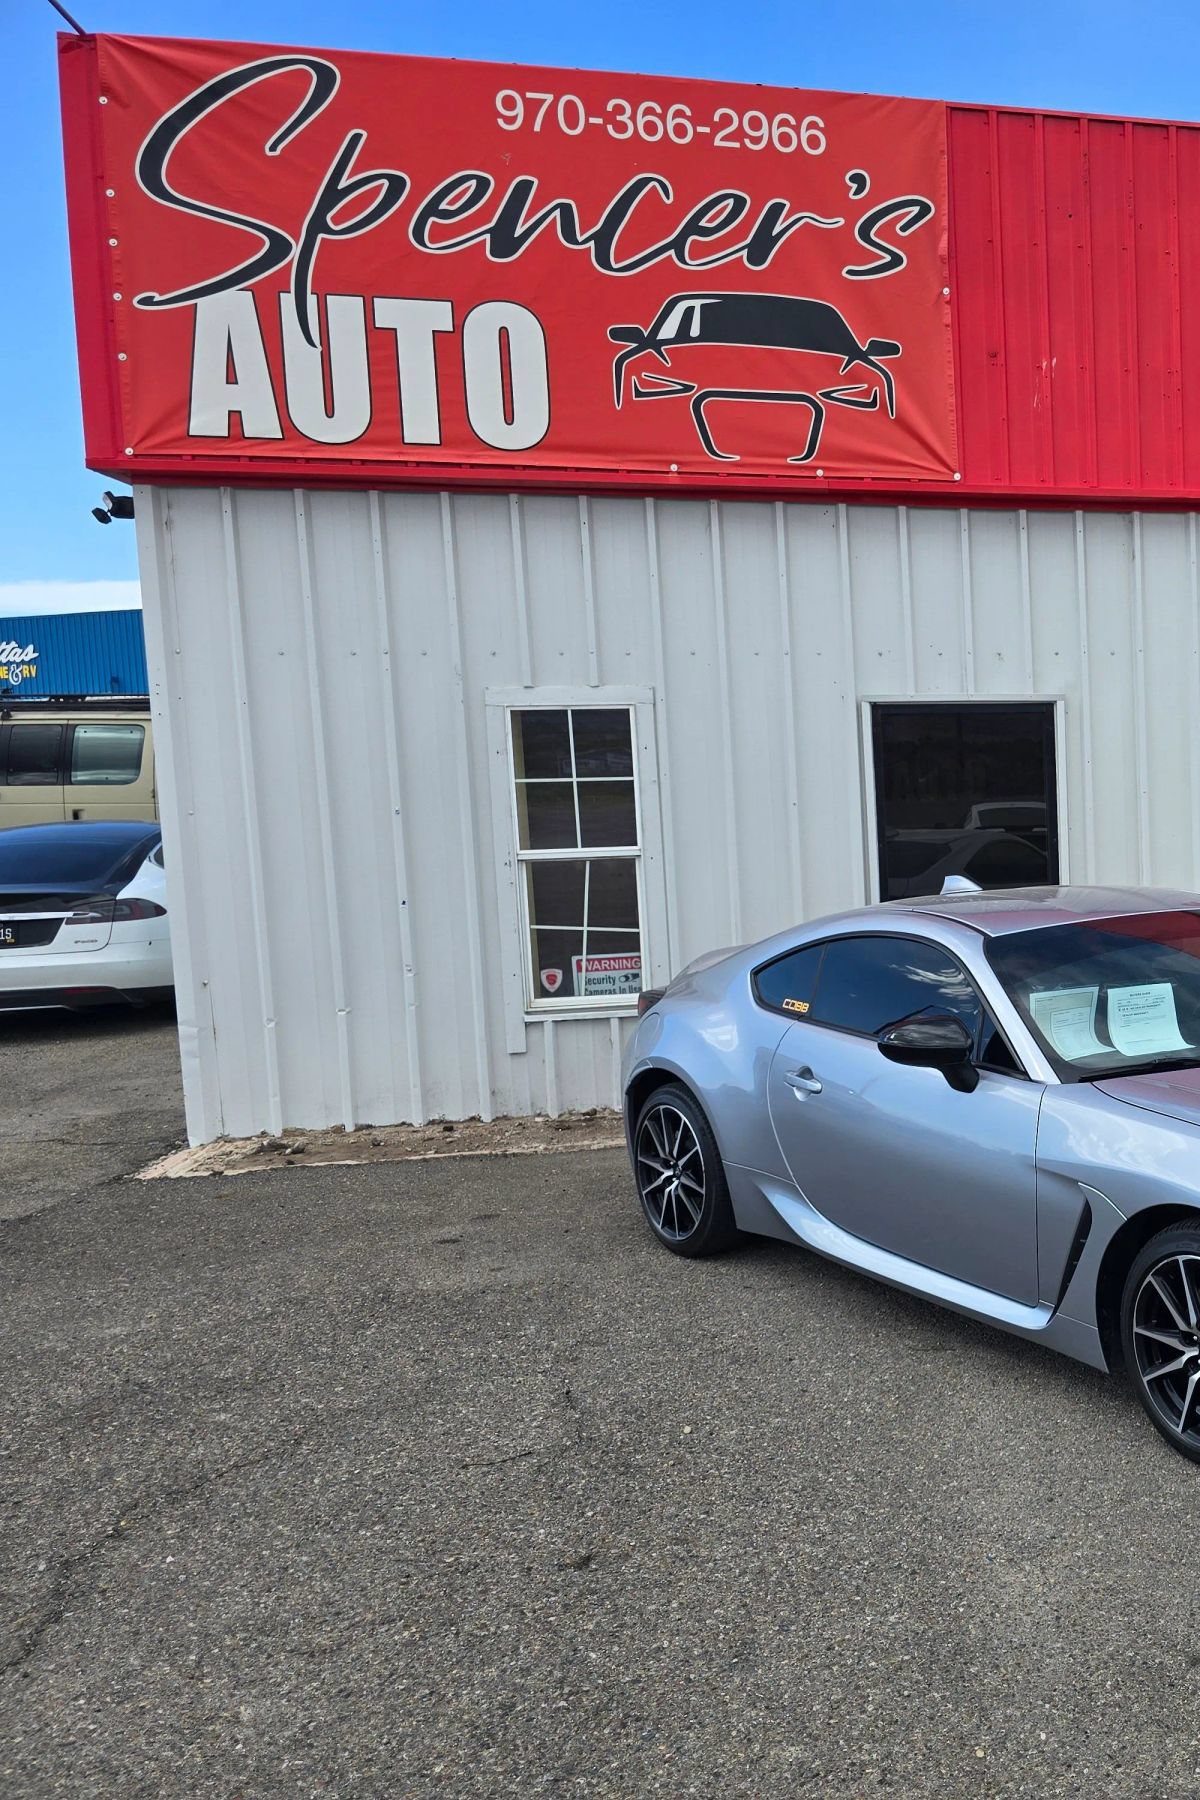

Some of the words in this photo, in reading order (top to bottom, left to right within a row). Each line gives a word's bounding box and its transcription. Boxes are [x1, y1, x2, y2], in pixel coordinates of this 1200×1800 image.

[494, 89, 827, 156] 970-366-2966
[132, 54, 936, 352] Spencer's
[187, 288, 551, 453] AUTO
[22, 665, 37, 678] RV
[581, 958, 641, 971] WARNING
